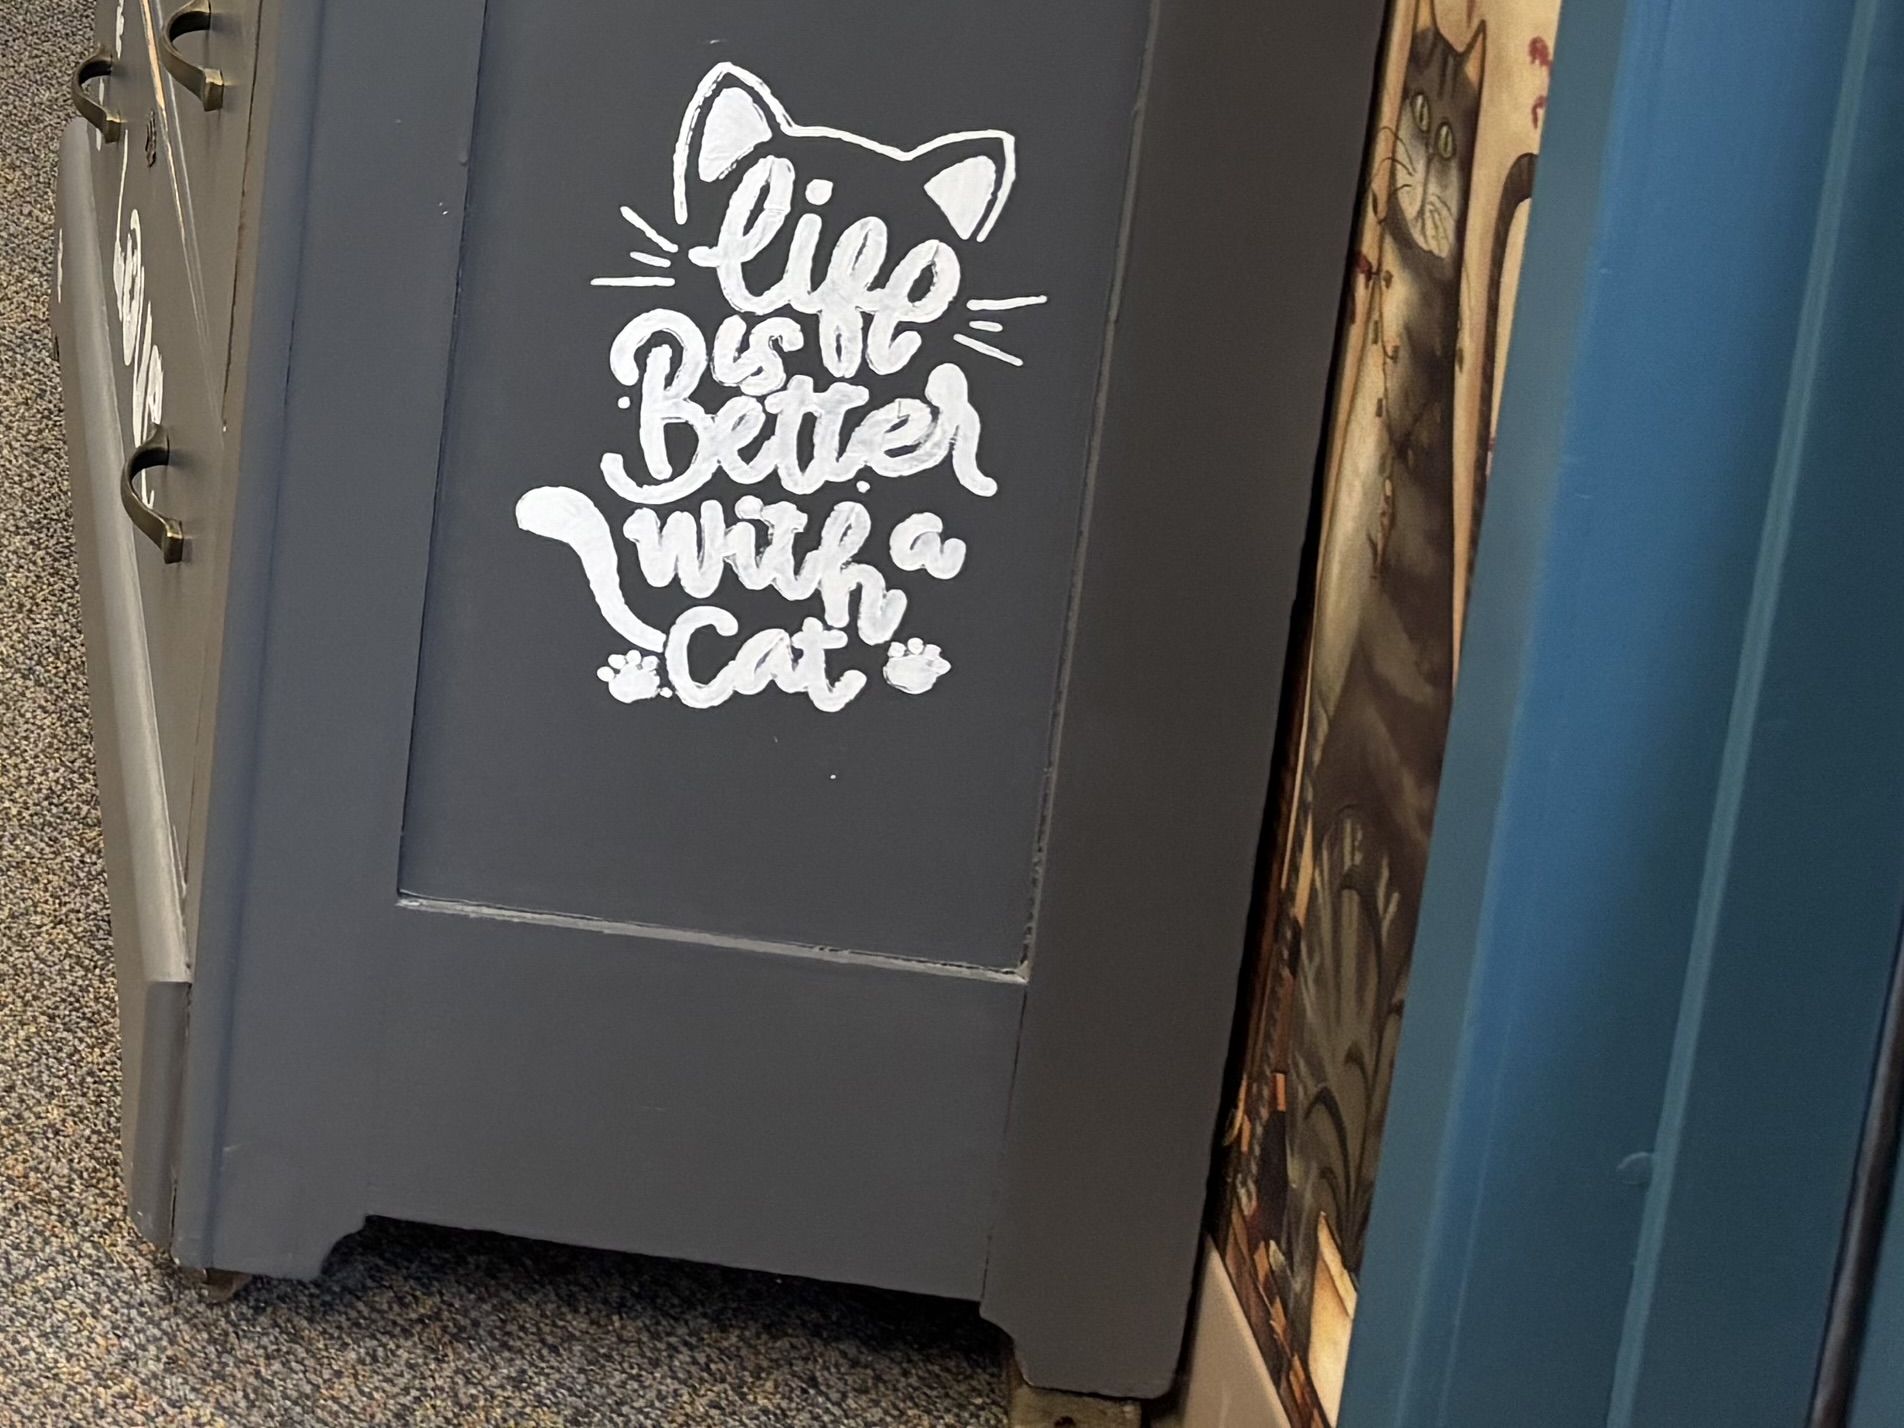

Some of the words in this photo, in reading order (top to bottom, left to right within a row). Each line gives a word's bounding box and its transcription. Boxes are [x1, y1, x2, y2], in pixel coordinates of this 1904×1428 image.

[711, 314, 804, 396] is
[600, 308, 998, 504] Better
[890, 511, 967, 580] a
[664, 605, 868, 712] Cat
